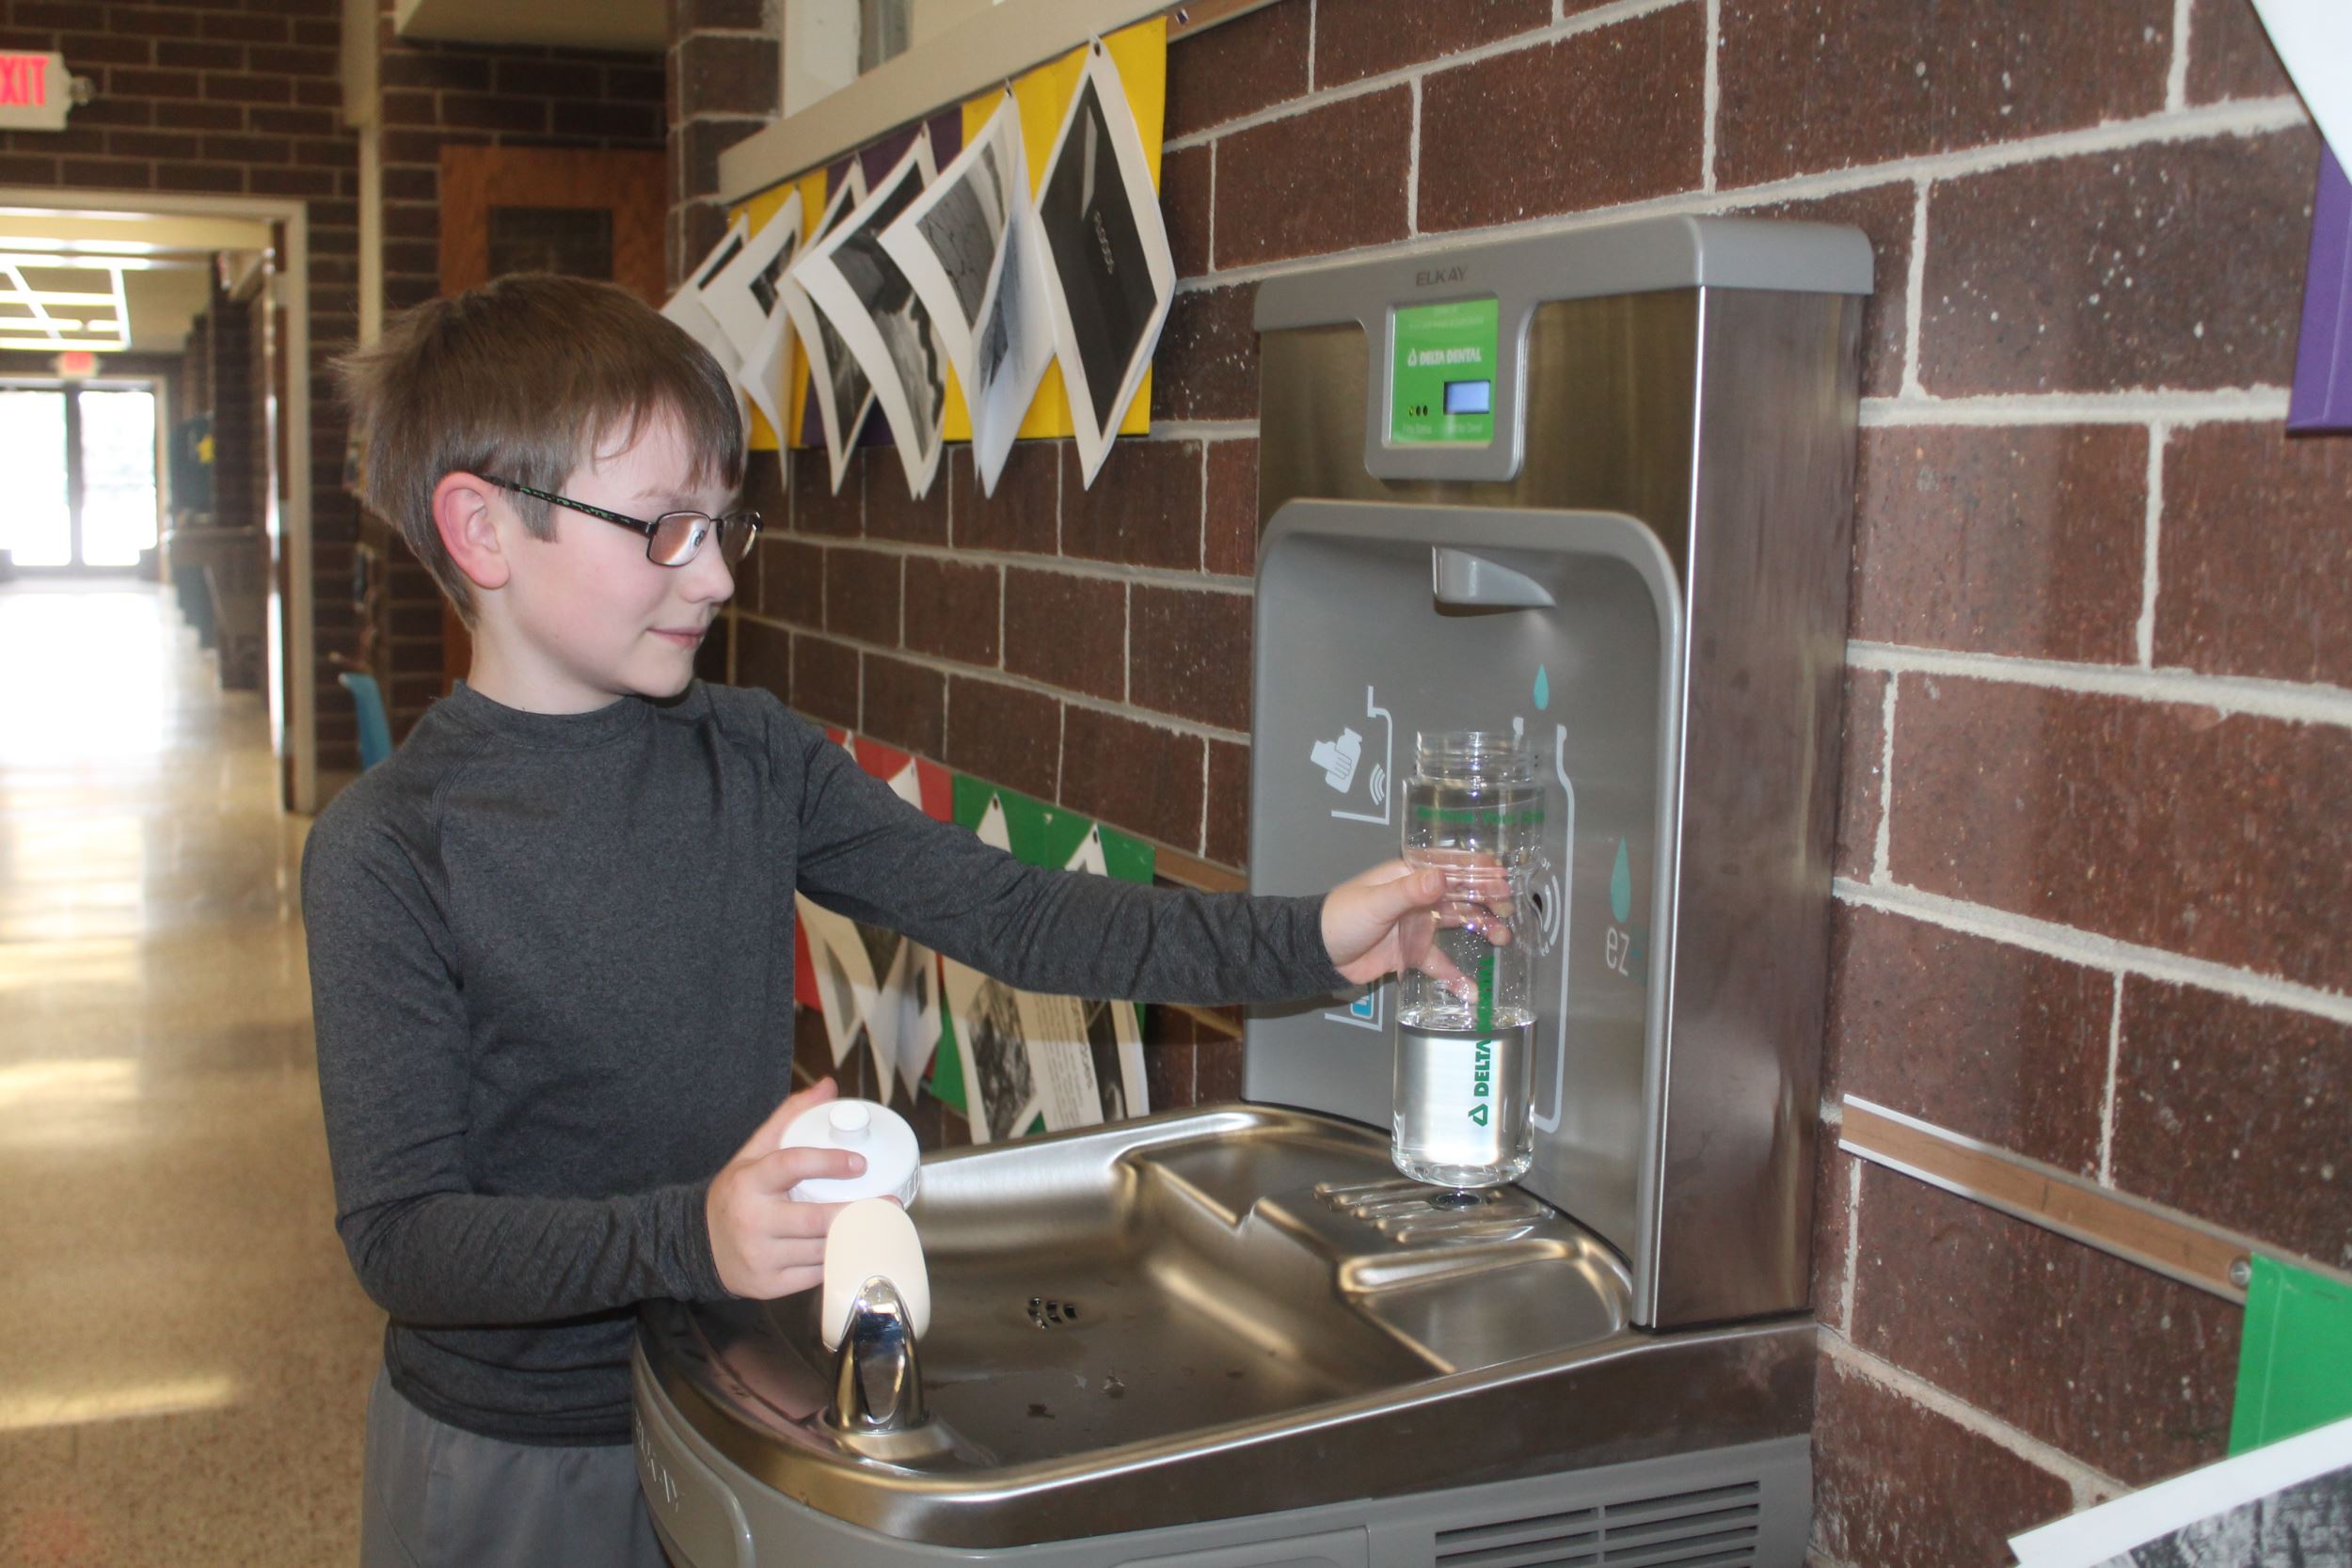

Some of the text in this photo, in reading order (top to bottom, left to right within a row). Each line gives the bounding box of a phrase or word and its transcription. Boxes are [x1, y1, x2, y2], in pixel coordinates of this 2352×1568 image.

[0, 55, 50, 106] XIT
[1415, 266, 1469, 287] ELKAY
[1419, 347, 1483, 366] DELTA DENTAL
[1473, 1037, 1492, 1098] DELTA
